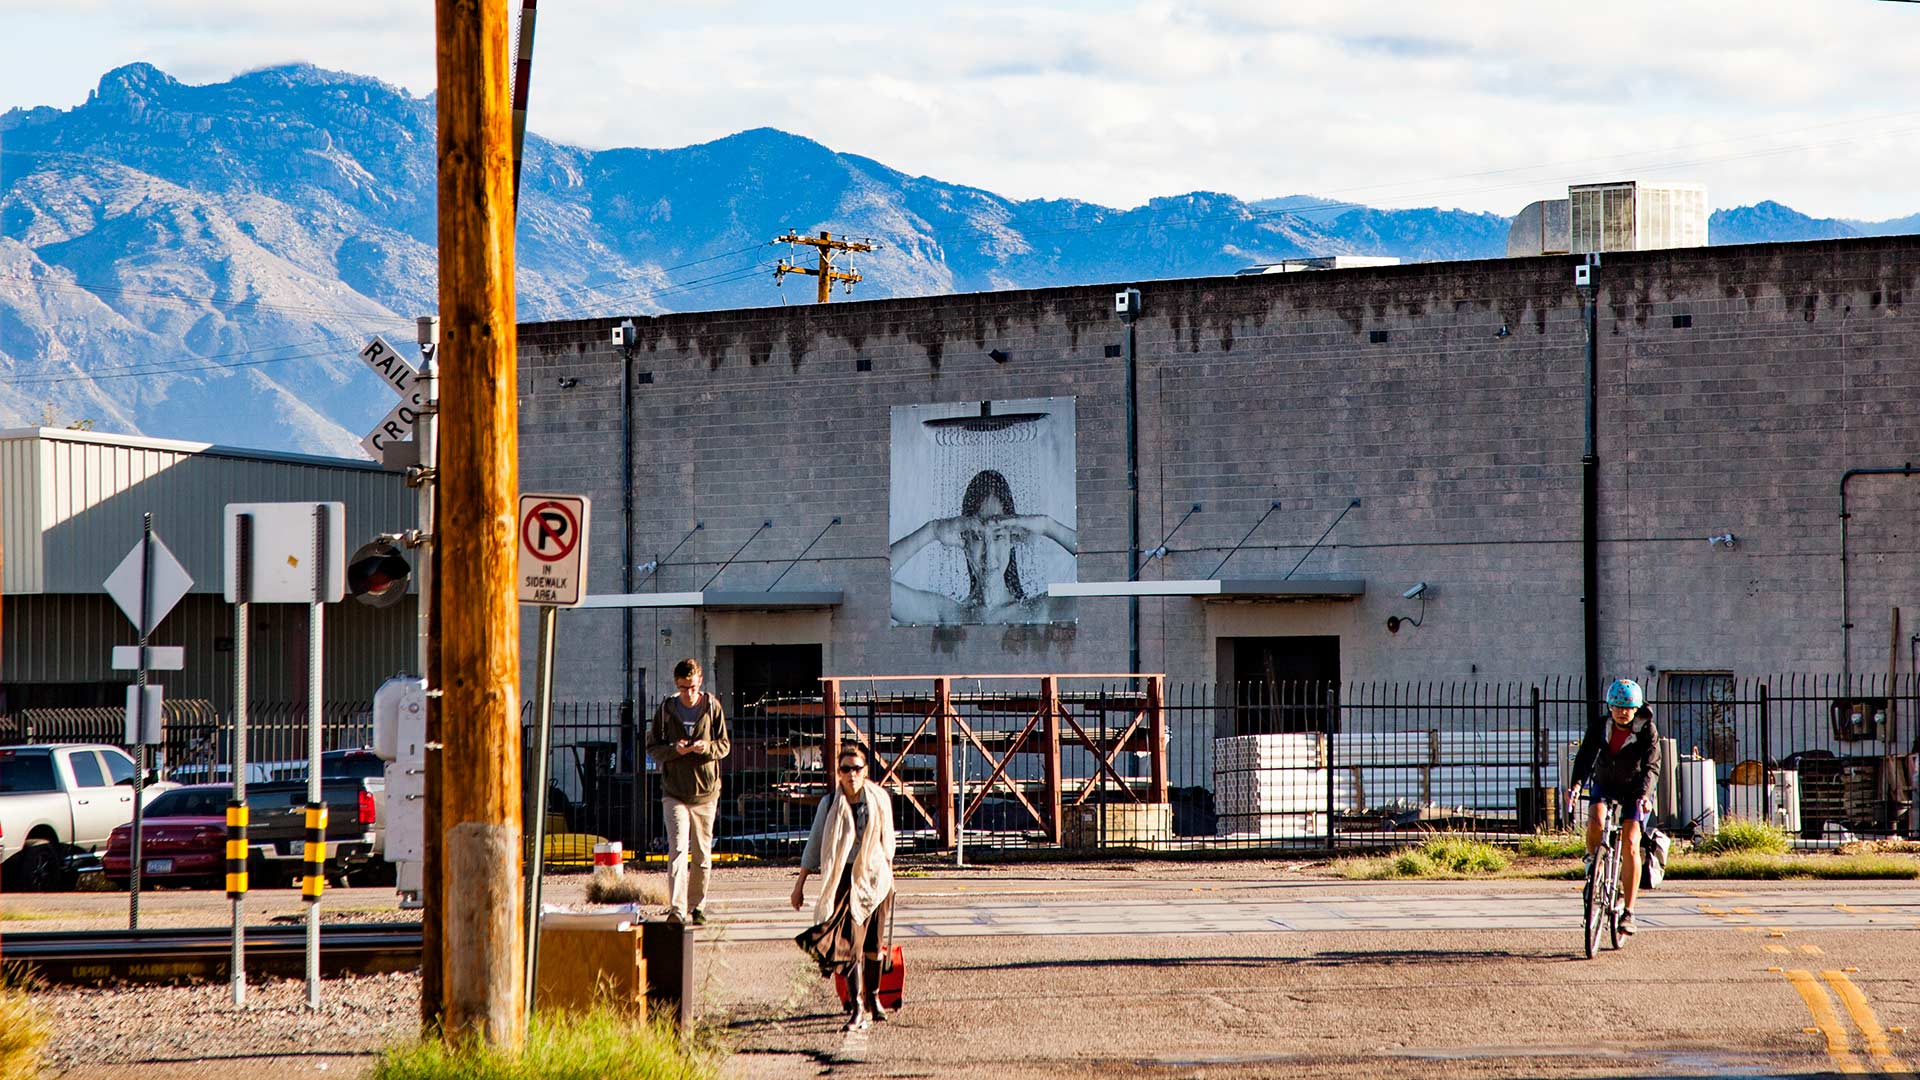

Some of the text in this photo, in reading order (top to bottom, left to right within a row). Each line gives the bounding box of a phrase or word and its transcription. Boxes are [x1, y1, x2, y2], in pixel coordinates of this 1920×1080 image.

[364, 341, 410, 391] RAIL
[538, 512, 567, 550] P
[542, 565, 552, 575] IN
[525, 576, 567, 589] SIDEWALK
[534, 588, 556, 601] AREA
